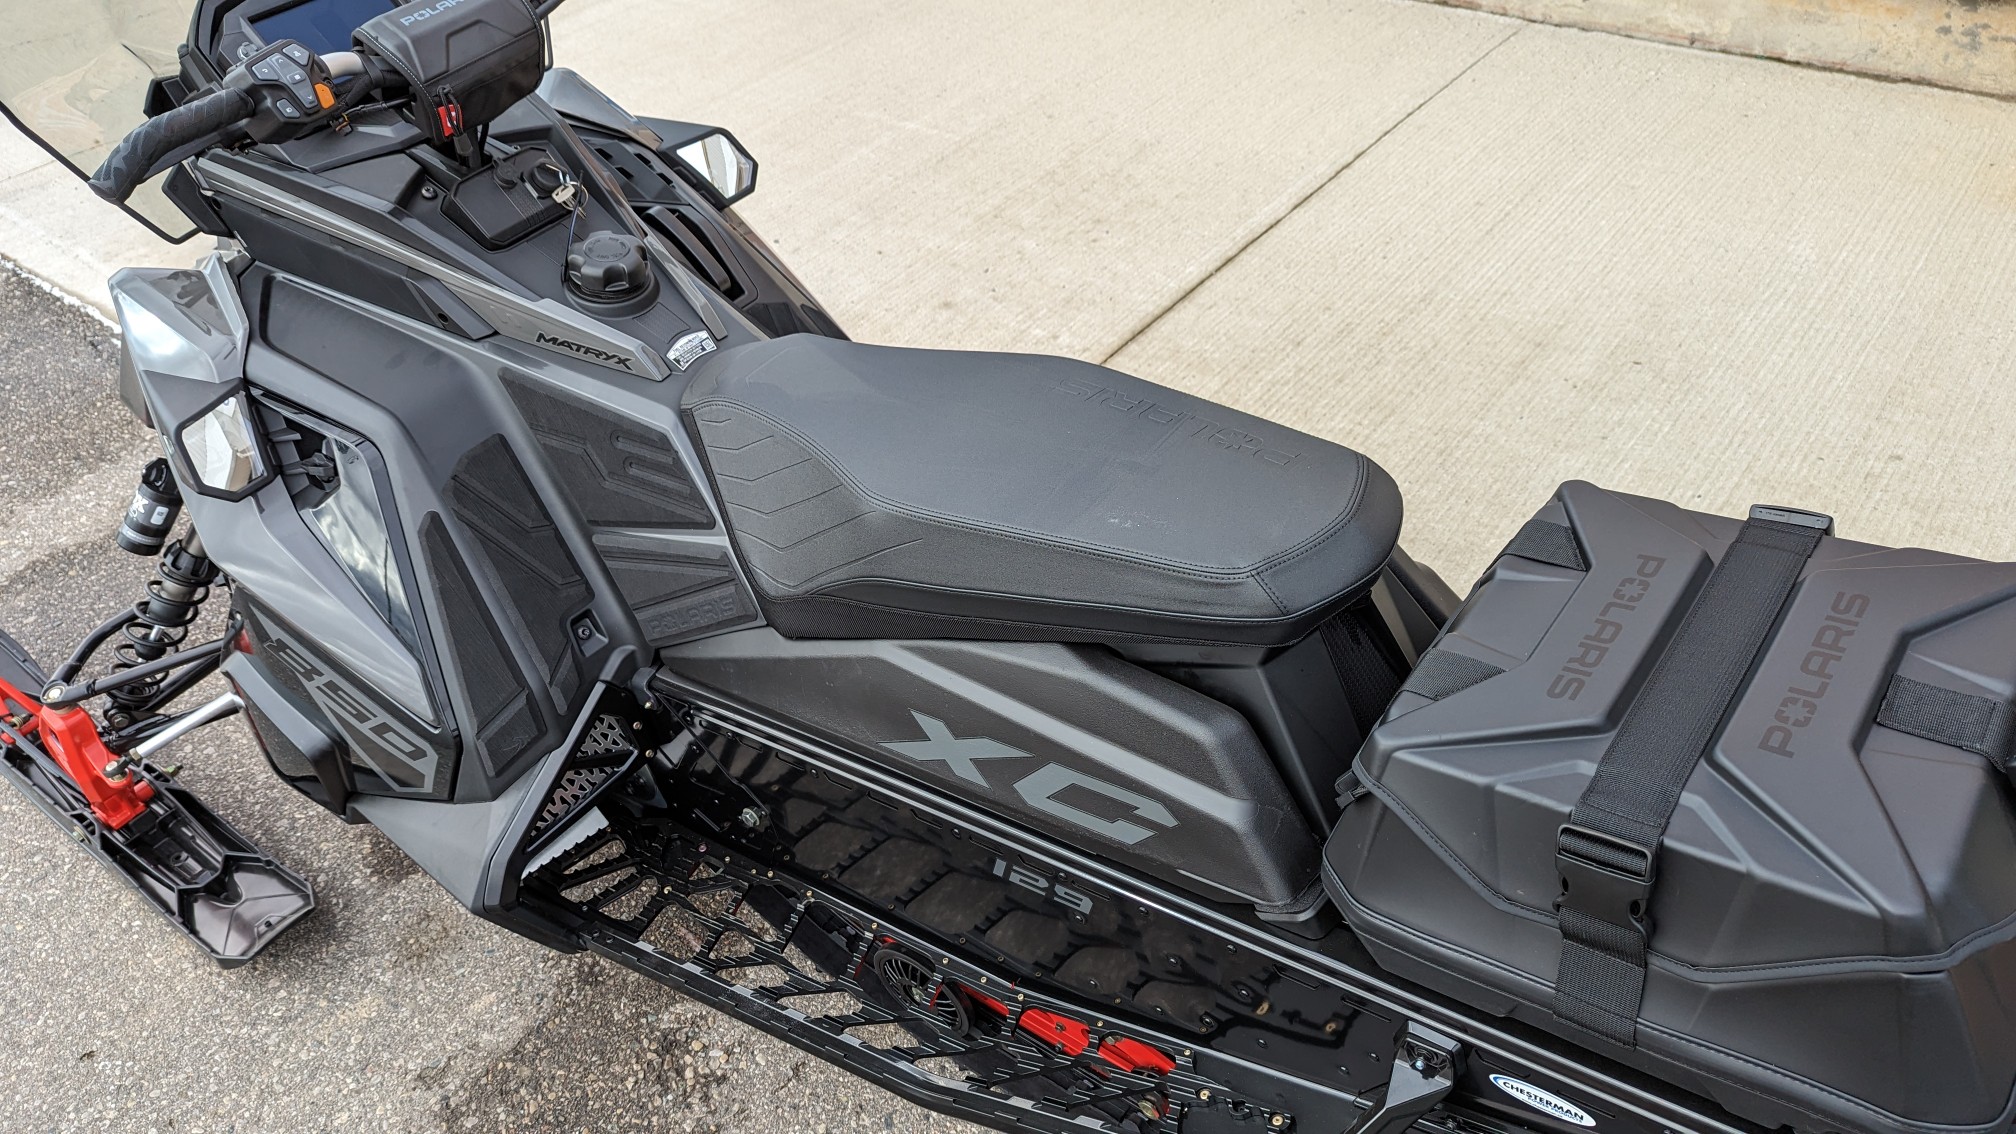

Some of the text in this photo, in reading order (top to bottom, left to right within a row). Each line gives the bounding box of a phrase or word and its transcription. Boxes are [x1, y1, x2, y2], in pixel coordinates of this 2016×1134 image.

[536, 332, 633, 371] MATRYX
[1546, 554, 1667, 701] POLARIS
[1757, 591, 1871, 759] POLARIS
[253, 637, 428, 761] 850
[876, 708, 1181, 845] XC
[993, 858, 1093, 915] 129
[1503, 1081, 1584, 1121] CHESTERMAN
